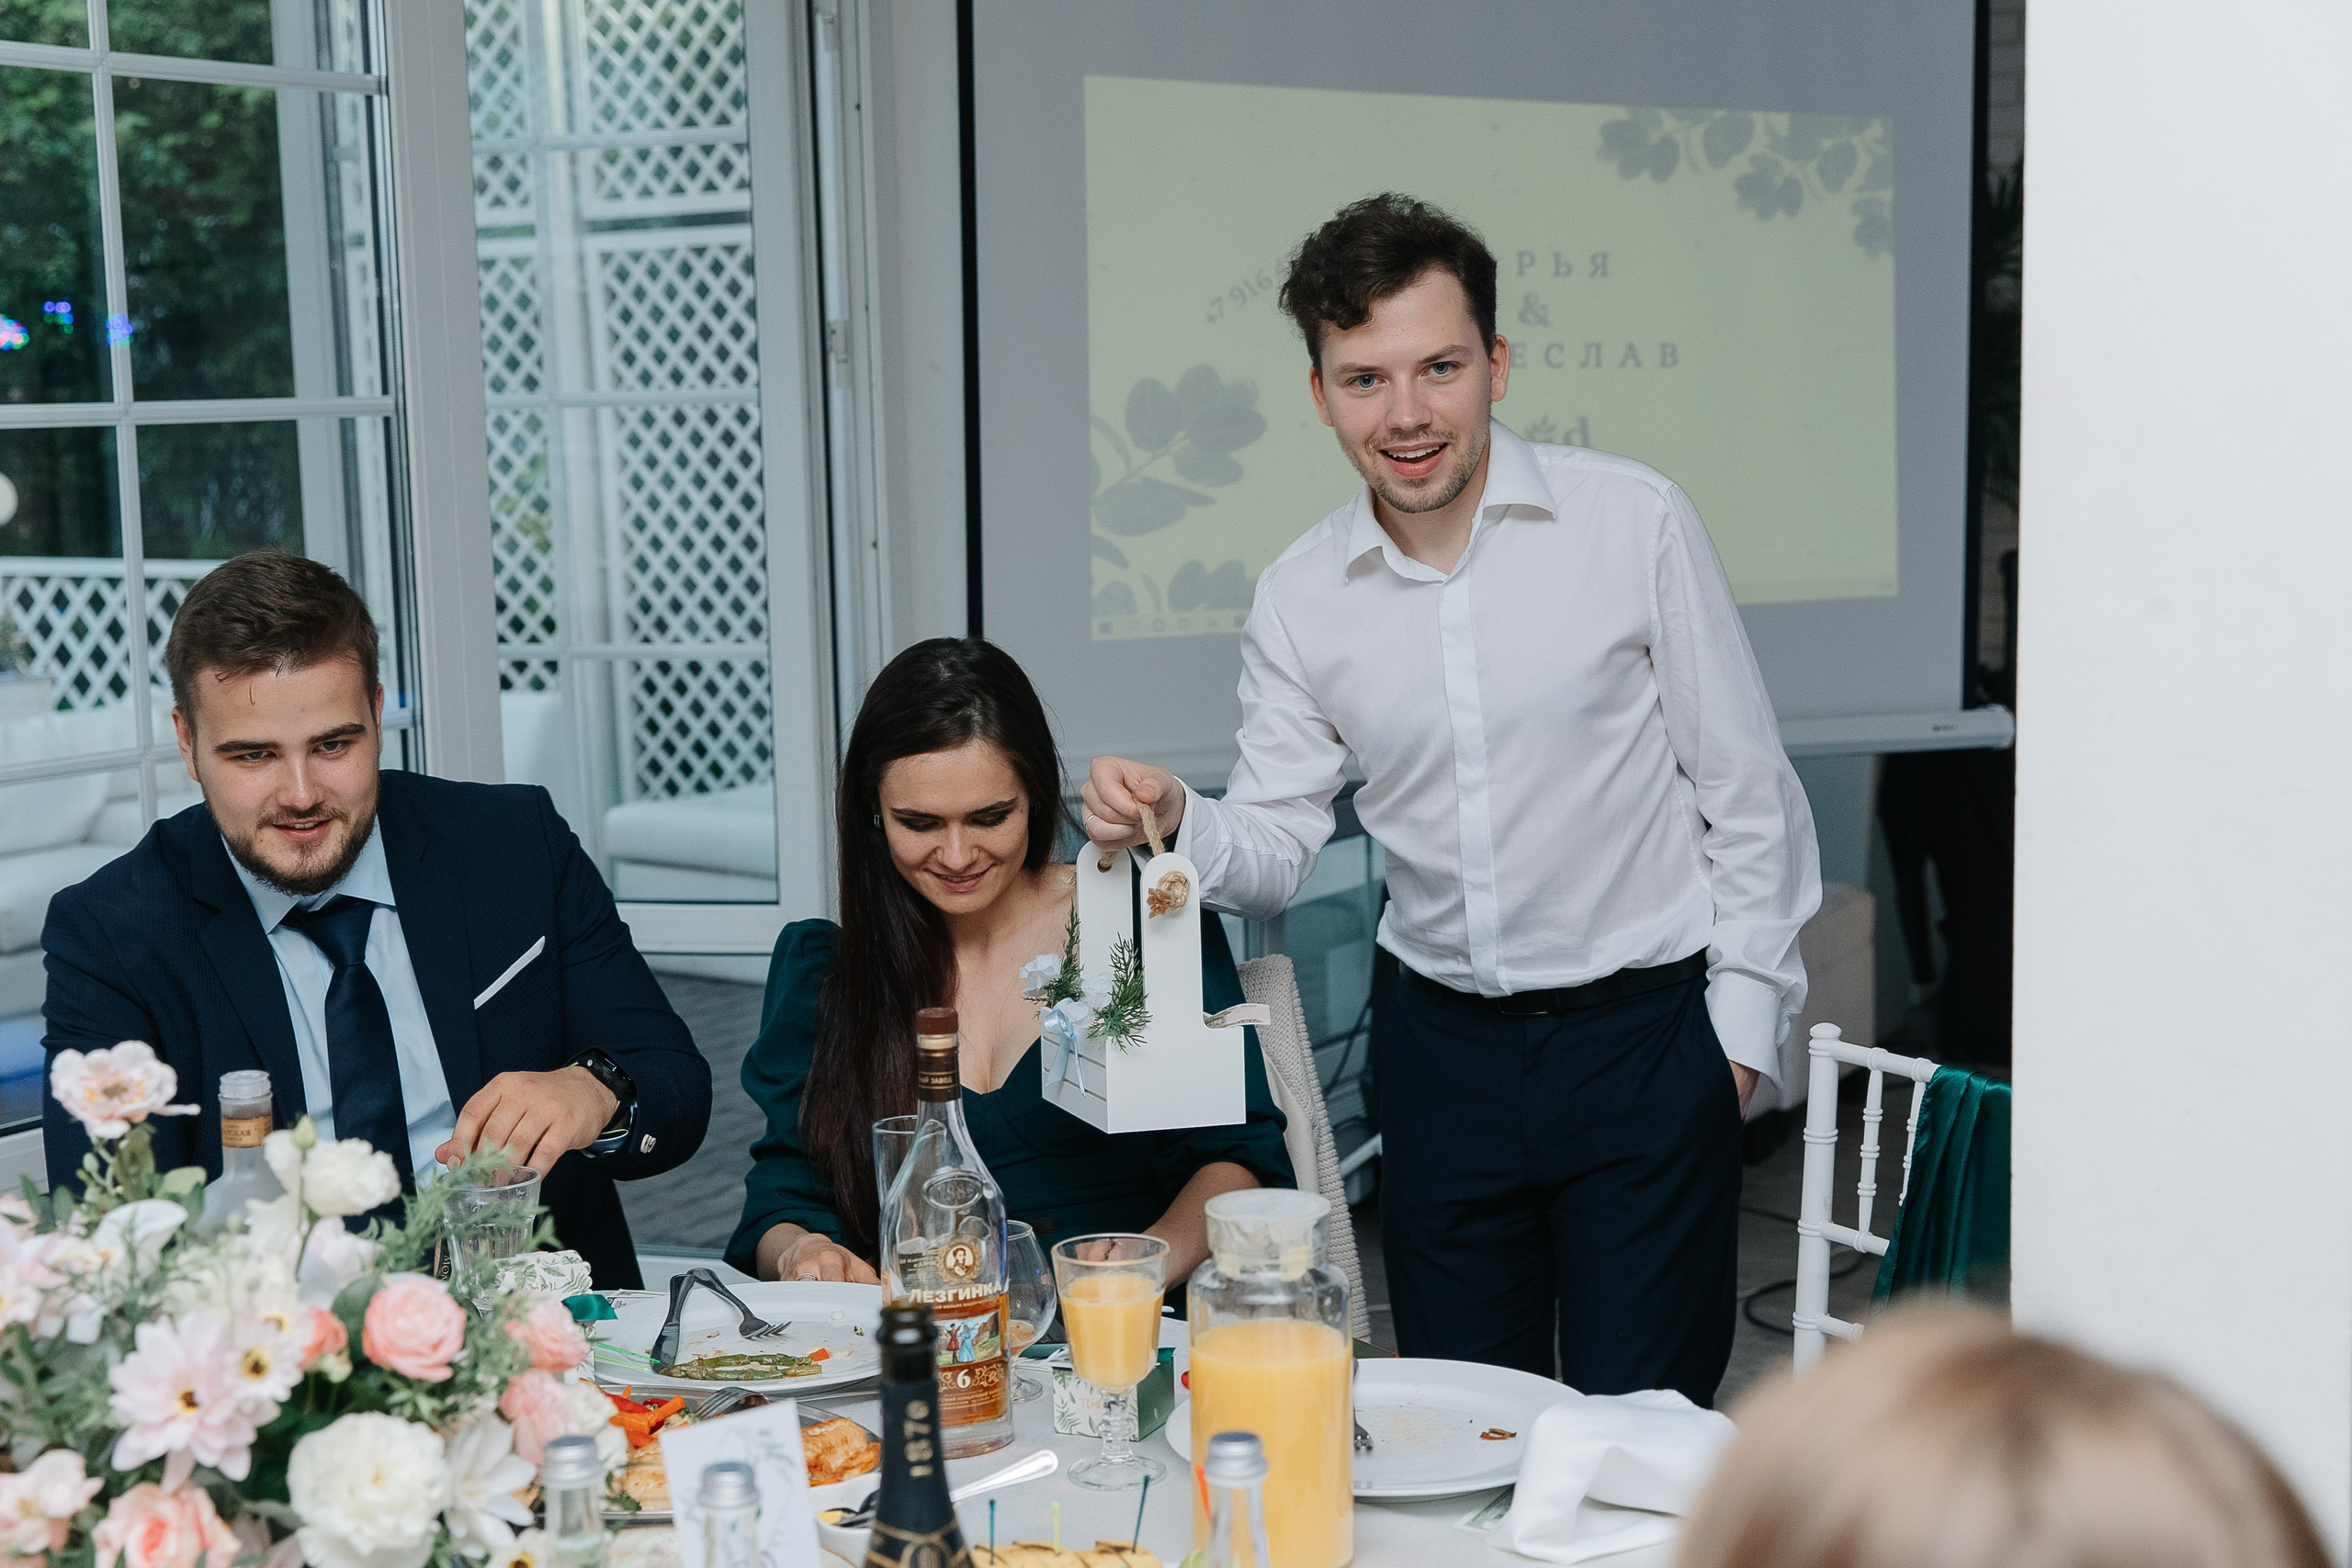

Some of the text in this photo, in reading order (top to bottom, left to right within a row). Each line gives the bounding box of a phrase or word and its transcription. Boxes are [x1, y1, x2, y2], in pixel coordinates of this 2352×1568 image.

[1517, 250, 1610, 278] РЬЯ
[1229, 269, 1274, 308] 916
[1519, 291, 1550, 327] &
[1510, 341, 1679, 369] ЕСЛАВ
[441, 1255, 451, 1280] MON
[908, 1280, 1002, 1303] ЛЕЗГИНКА
[956, 1369, 971, 1389] 6
[903, 1399, 934, 1477] 1870
